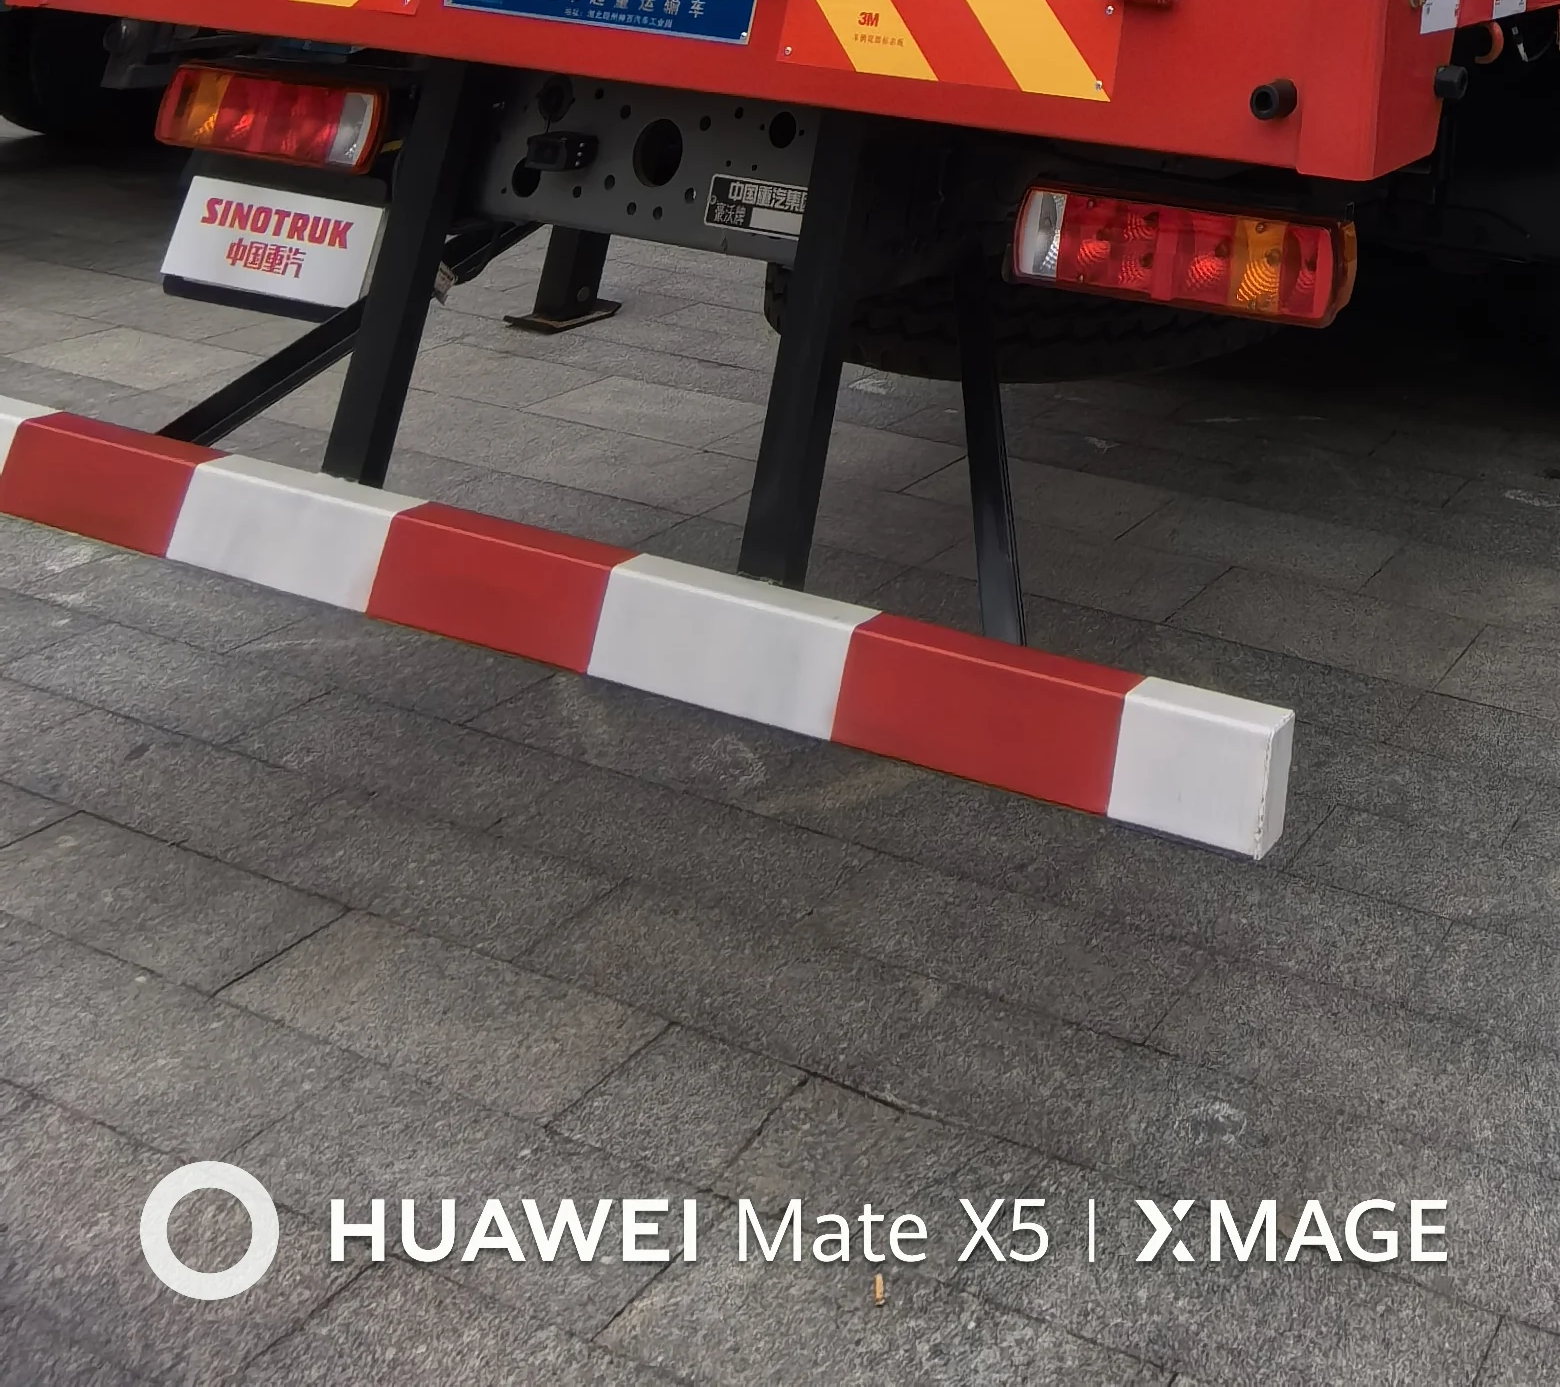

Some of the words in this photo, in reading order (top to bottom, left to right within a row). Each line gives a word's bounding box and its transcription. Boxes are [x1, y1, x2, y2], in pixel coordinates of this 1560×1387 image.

[857, 11, 880, 28] 3M
[200, 197, 355, 250] SINOTRUK
[225, 237, 307, 279] 中国重汽
